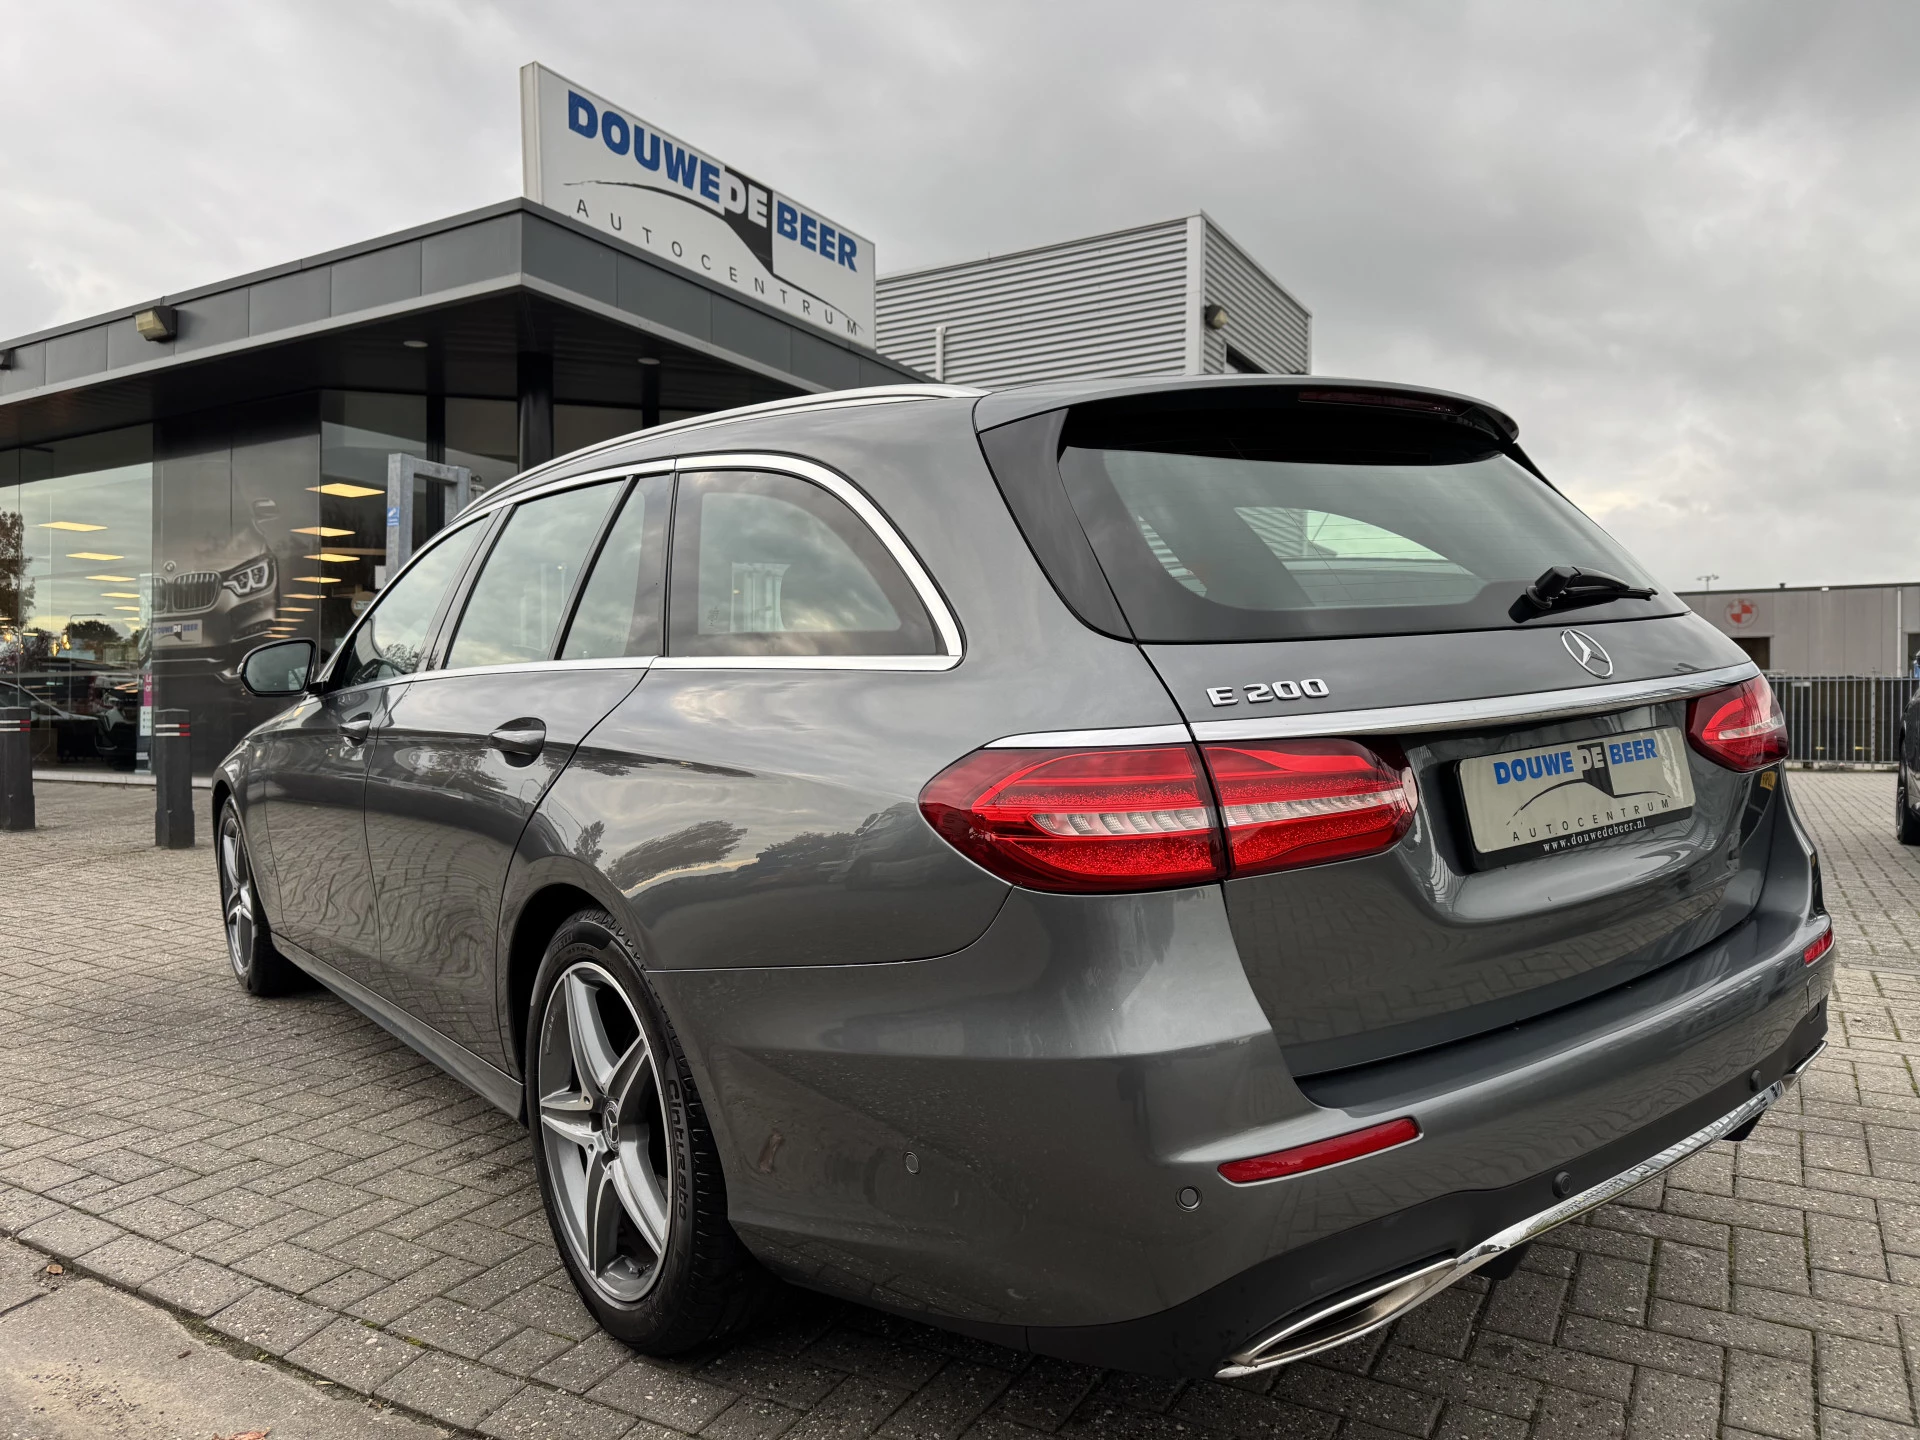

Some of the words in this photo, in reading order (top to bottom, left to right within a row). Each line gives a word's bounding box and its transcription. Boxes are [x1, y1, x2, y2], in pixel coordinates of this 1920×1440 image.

[568, 89, 720, 204] DOUWE
[721, 166, 768, 228] DE
[777, 200, 857, 272] BEER
[577, 199, 857, 336] AUTOCENTRUM
[1206, 686, 1239, 707] E
[1243, 678, 1330, 704] 200
[1493, 751, 1574, 784] DOUWE
[1580, 747, 1605, 771] DE
[1608, 738, 1658, 765] BEER
[1512, 798, 1670, 842] AUTOCENTRUM
[1543, 817, 1646, 852] www.douwedebeer.nl
